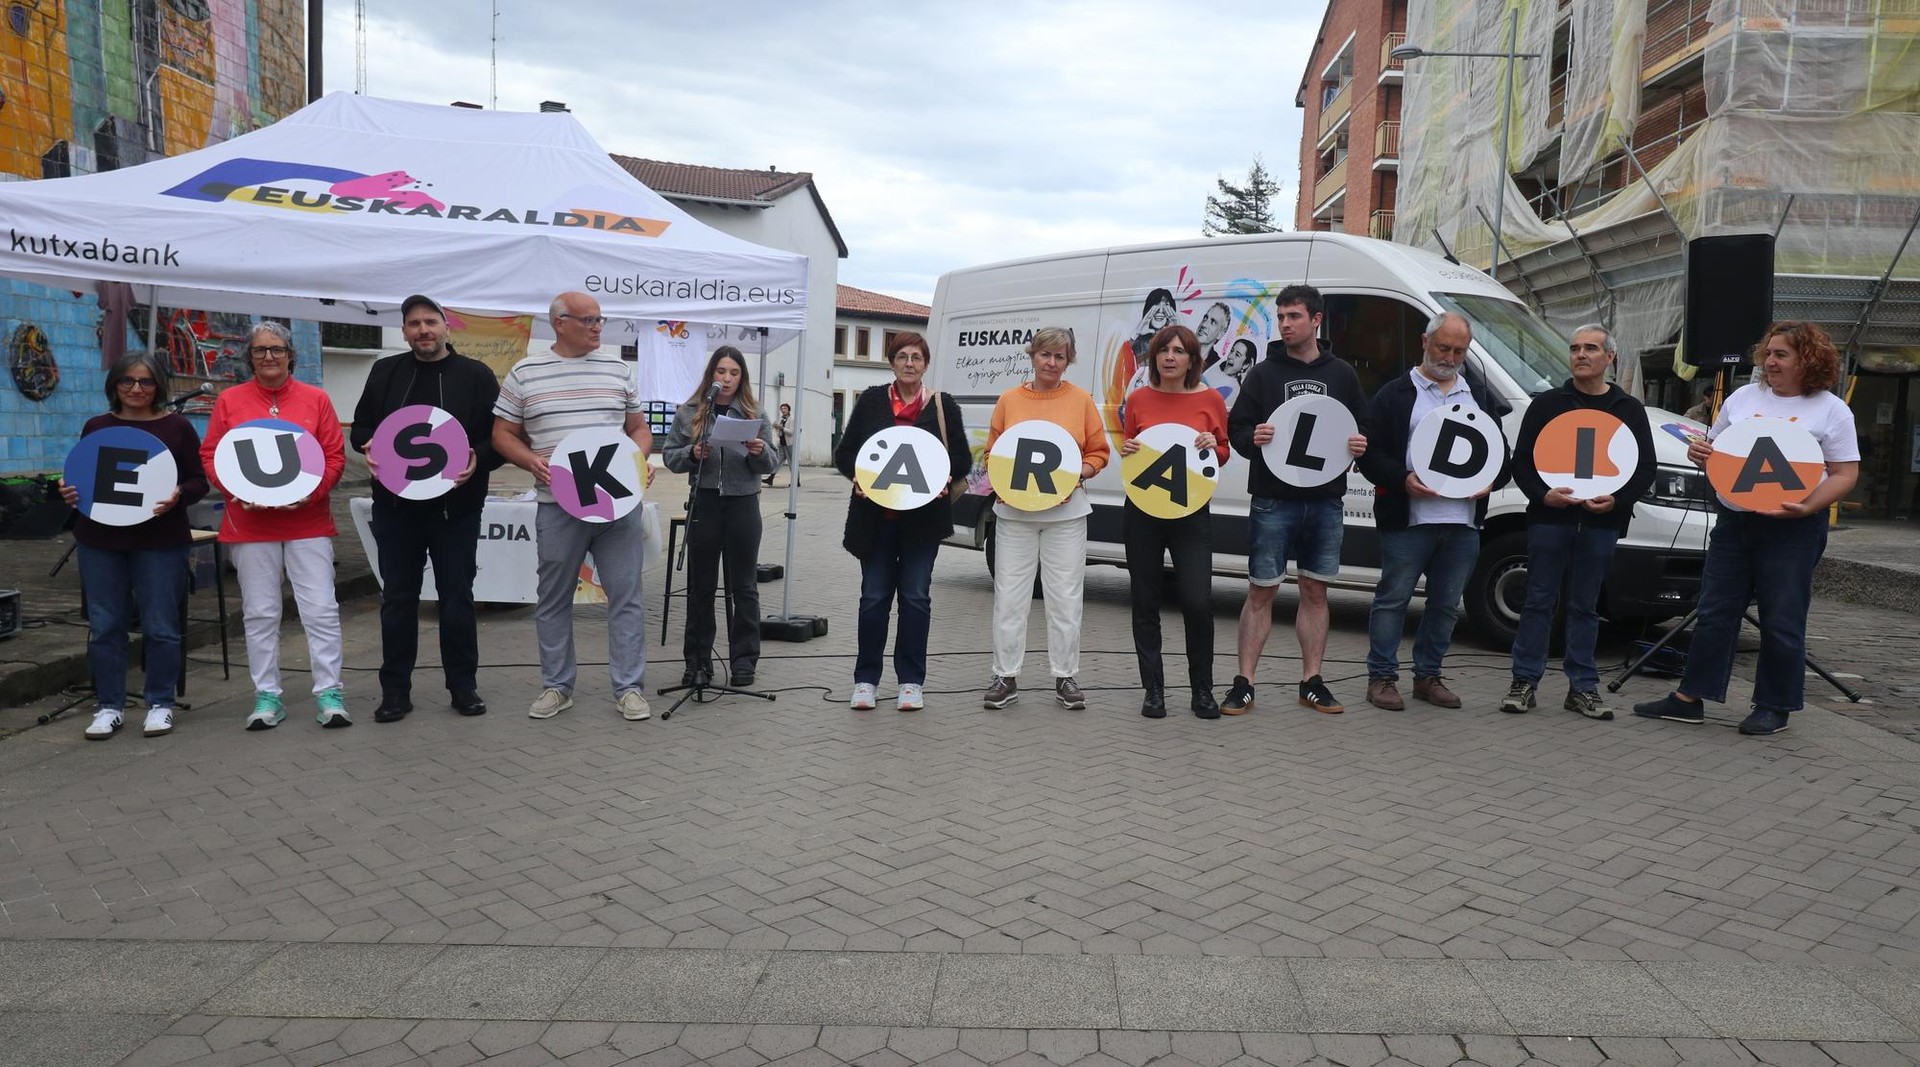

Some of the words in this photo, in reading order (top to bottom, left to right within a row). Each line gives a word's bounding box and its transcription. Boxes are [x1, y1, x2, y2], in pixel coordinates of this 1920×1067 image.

[252, 185, 646, 232] EUSKARALDIA
[10, 228, 180, 267] kutxabank
[585, 273, 796, 305] euskaraldia.eus
[233, 433, 302, 488] U
[394, 423, 448, 480] S
[871, 443, 930, 494] A
[1010, 438, 1061, 494] R
[1285, 412, 1325, 471] L
[1429, 422, 1488, 475] D
[1575, 428, 1594, 478] I
[1731, 437, 1806, 493] A
[91, 446, 149, 506] E
[567, 444, 633, 507] K
[1130, 444, 1187, 508] A
